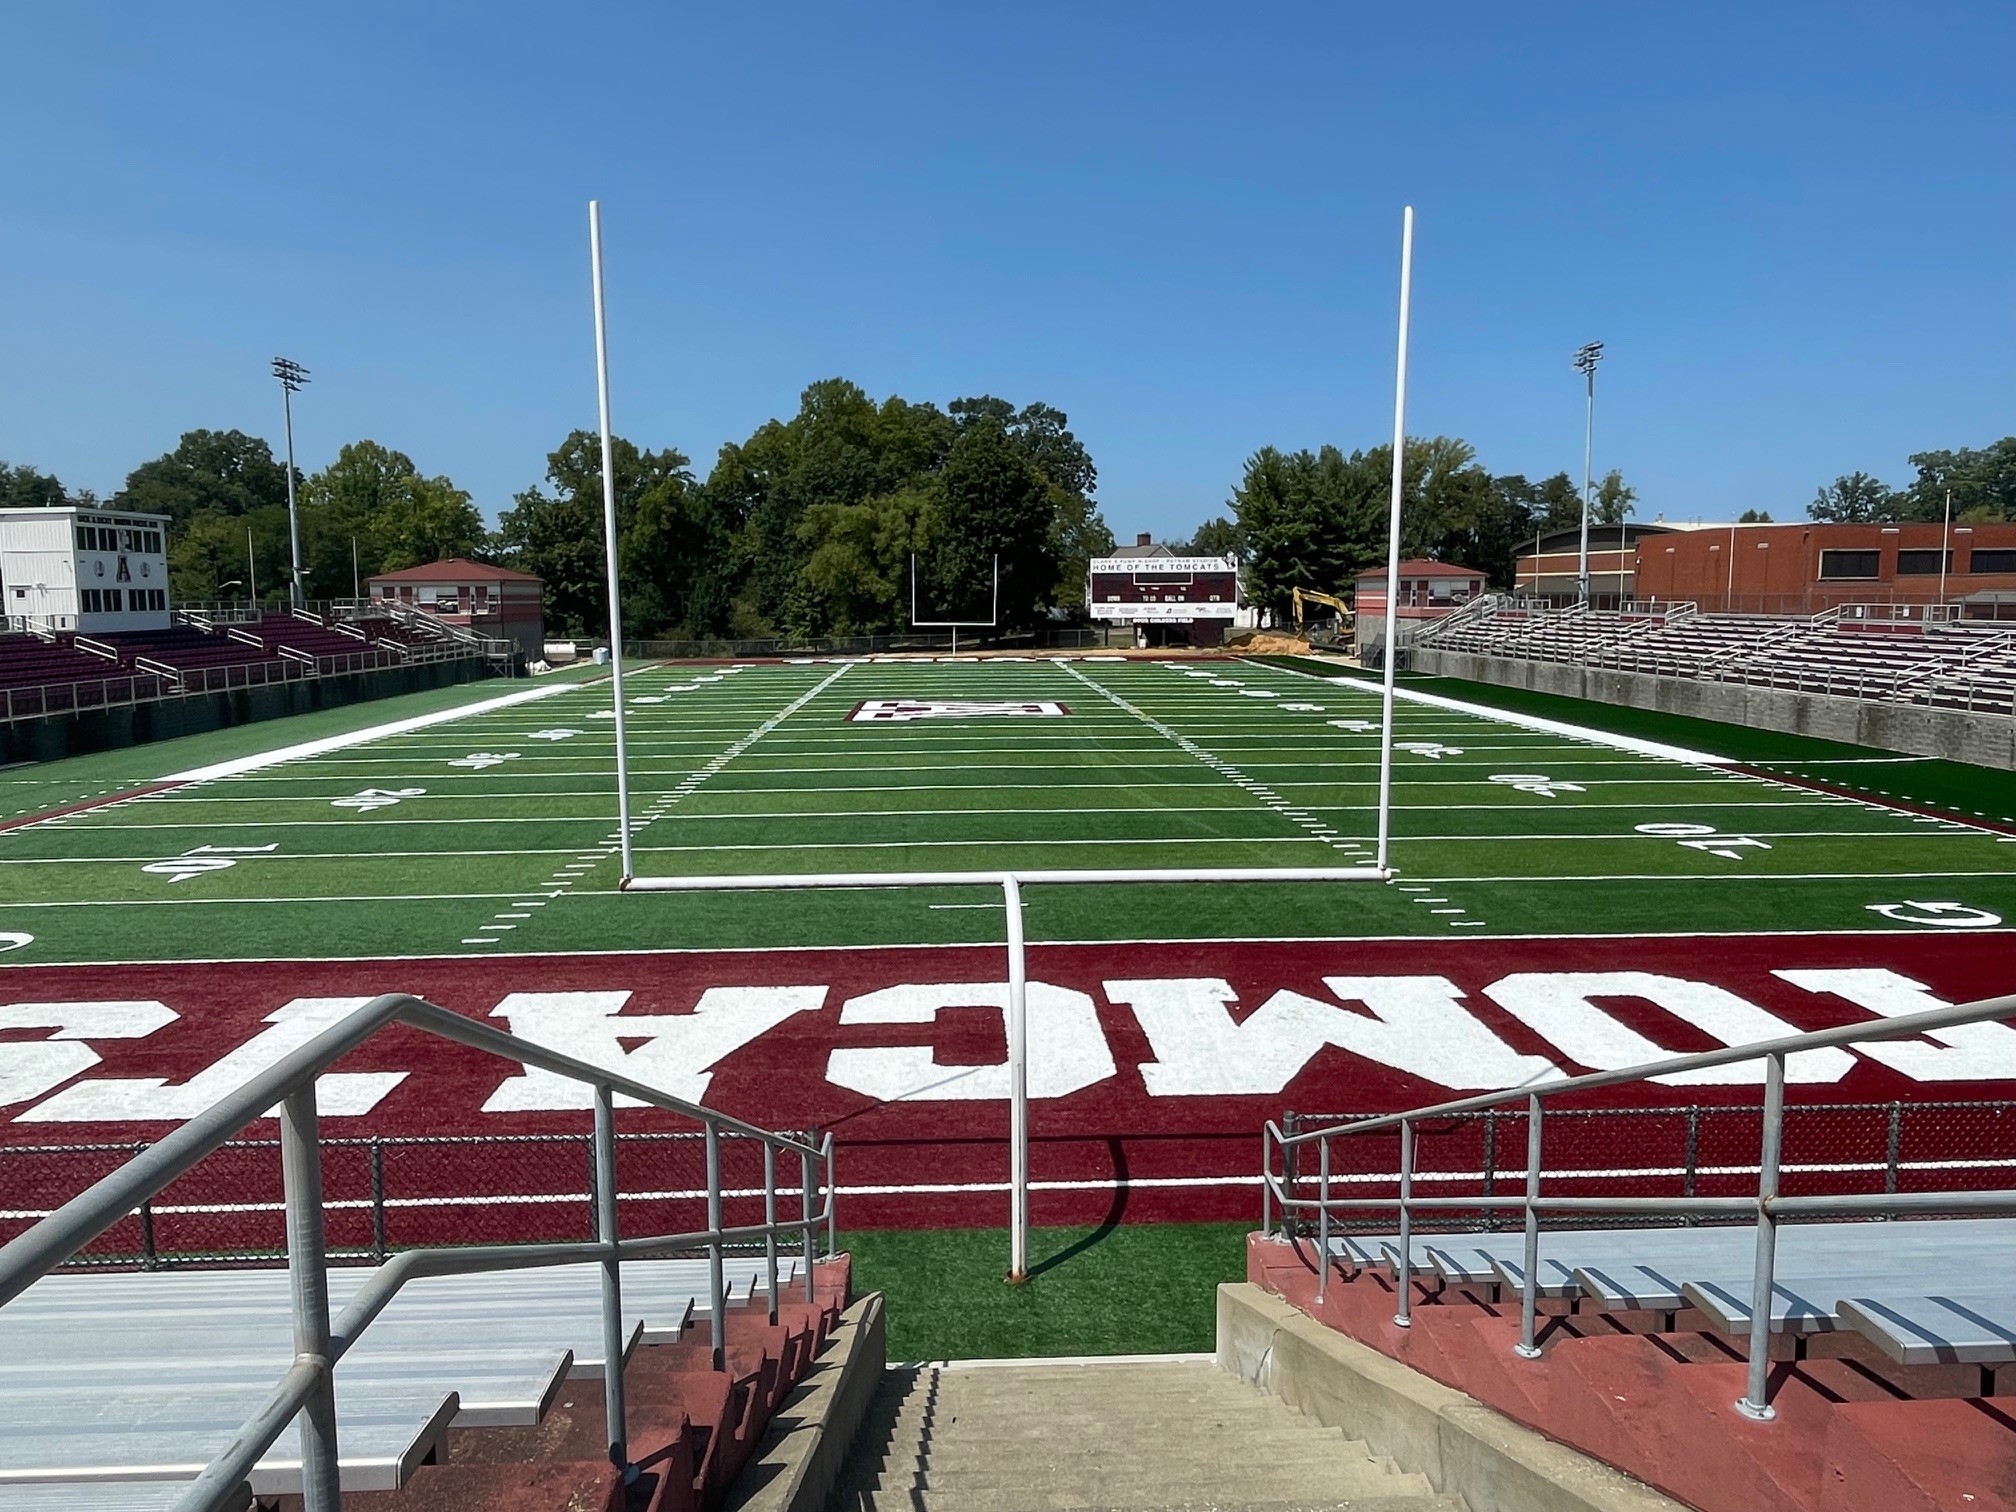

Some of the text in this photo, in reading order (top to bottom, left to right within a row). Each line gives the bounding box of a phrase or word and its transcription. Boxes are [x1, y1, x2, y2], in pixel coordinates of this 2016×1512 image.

[116, 555, 132, 582] A
[1170, 563, 1219, 571] TOMCATS
[1633, 823, 1773, 851] 10
[141, 842, 280, 874] 10
